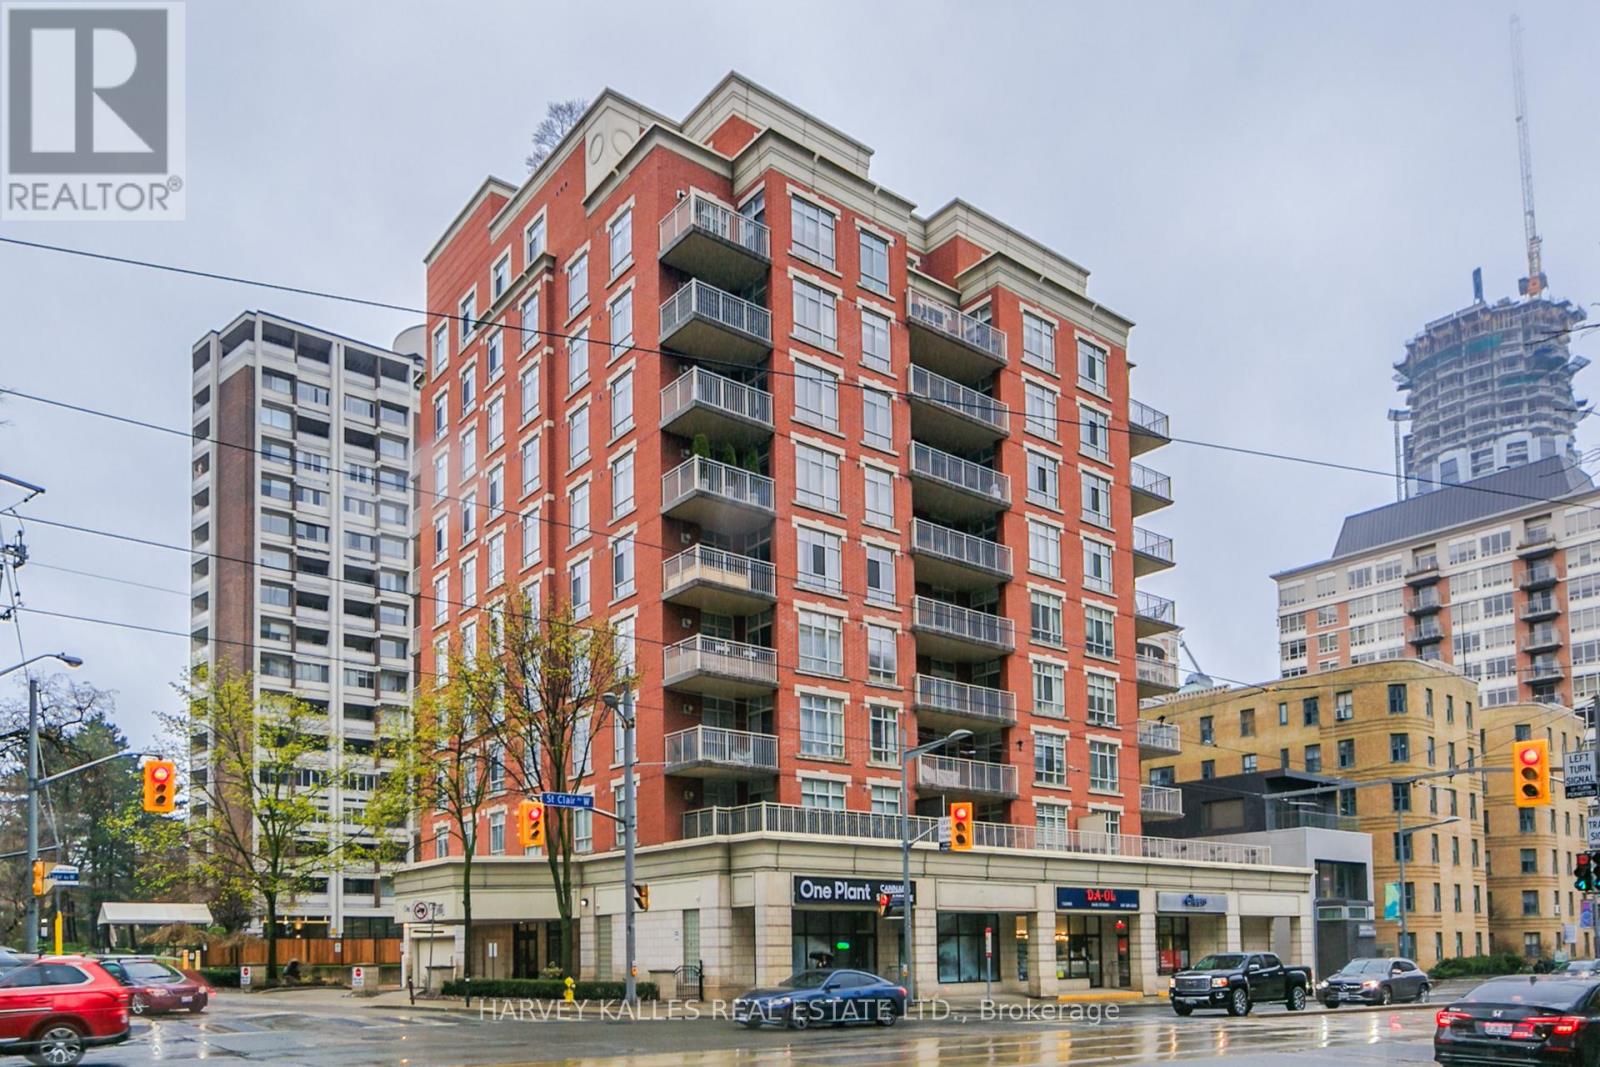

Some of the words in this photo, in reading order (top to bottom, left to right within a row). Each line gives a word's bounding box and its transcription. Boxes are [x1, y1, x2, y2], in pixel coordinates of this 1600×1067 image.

[1569, 753, 1589, 763] LEFT
[1569, 764, 1591, 774] TURN
[1566, 775, 1595, 785] SIGNAL
[546, 794, 555, 804] St
[557, 795, 576, 805] Clair
[583, 797, 591, 806] W
[800, 879, 832, 899] One
[834, 880, 871, 900] Plant
